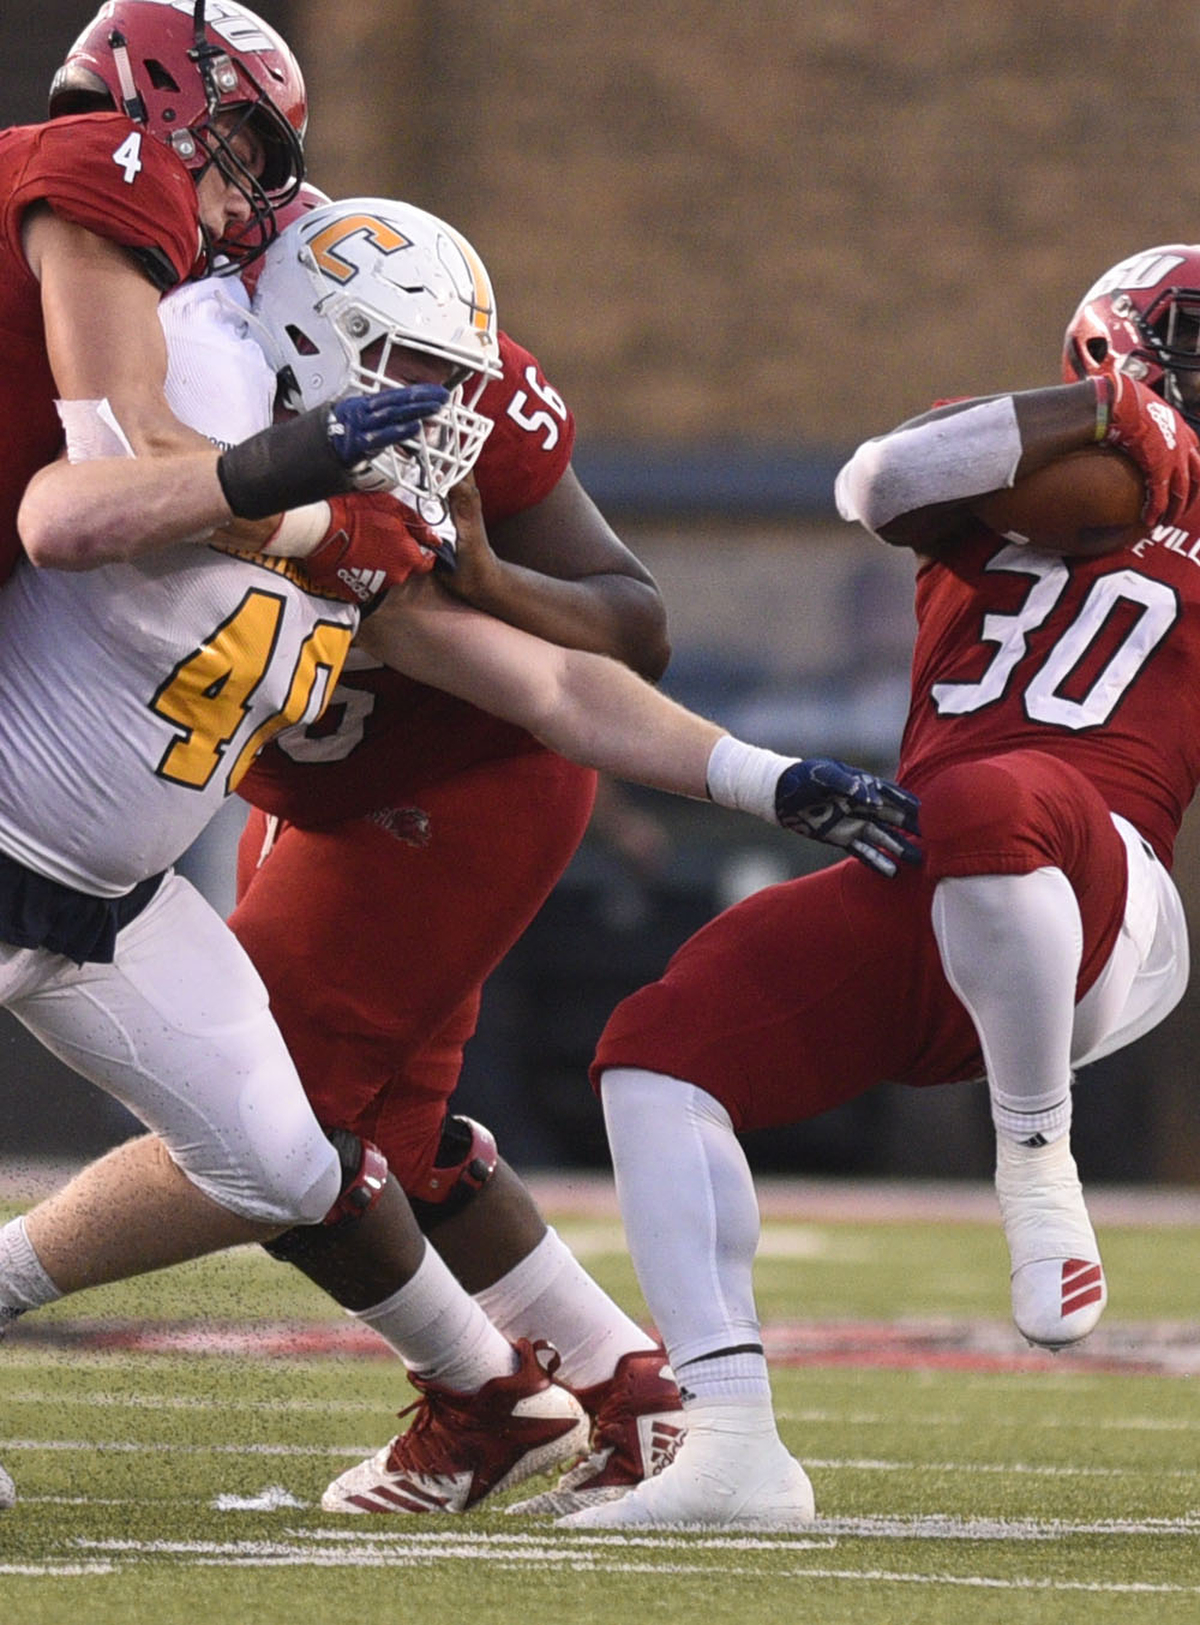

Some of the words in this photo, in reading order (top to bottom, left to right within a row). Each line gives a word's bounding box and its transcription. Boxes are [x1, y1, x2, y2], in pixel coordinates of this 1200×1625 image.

[112, 131, 142, 183] 4
[304, 214, 413, 286] C
[506, 366, 568, 451] 56
[928, 545, 1180, 732] 30
